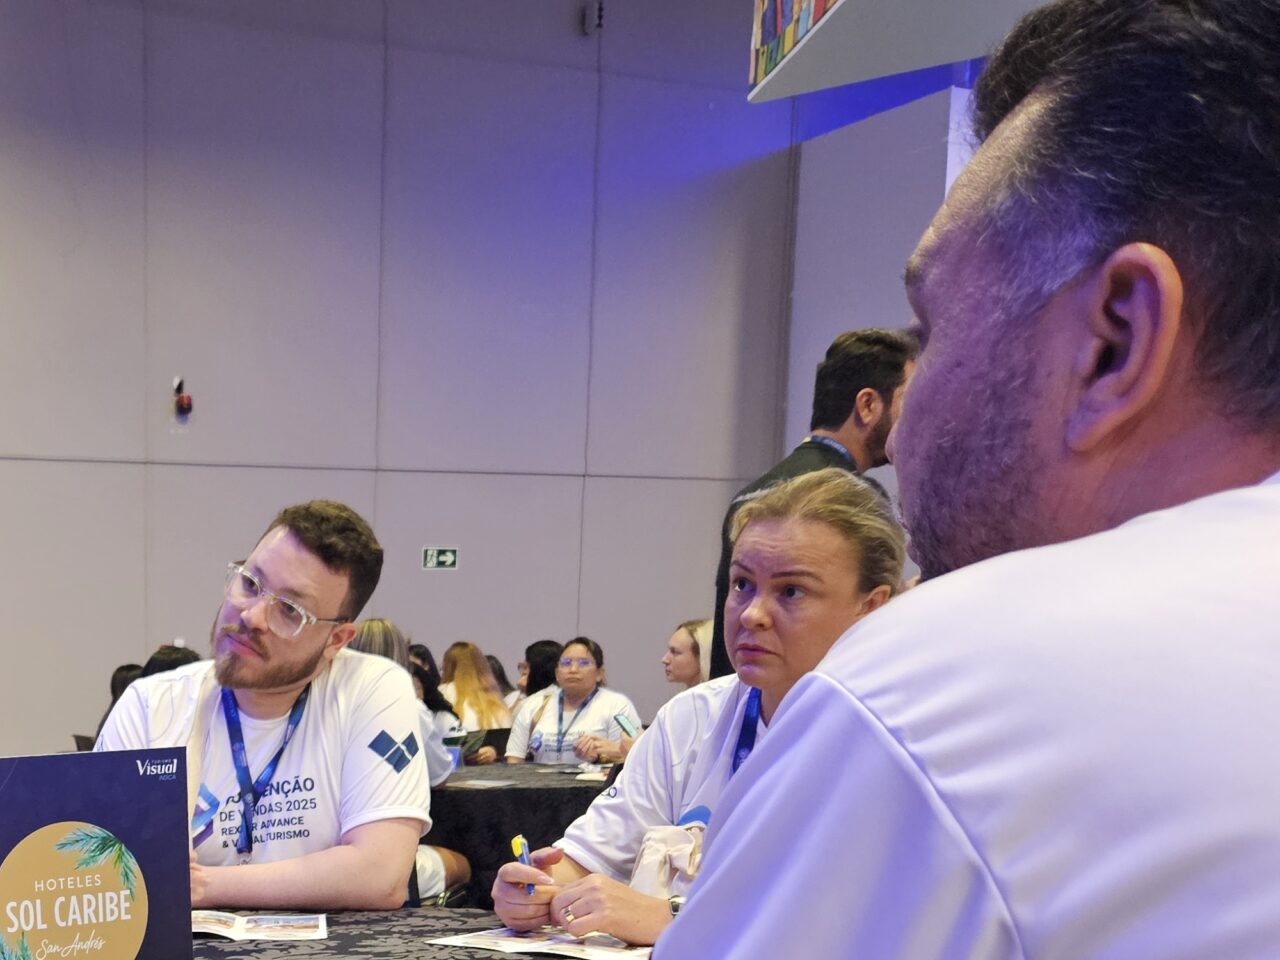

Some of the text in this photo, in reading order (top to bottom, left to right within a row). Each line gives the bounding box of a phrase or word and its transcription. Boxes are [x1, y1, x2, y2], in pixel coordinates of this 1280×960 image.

[136, 758, 178, 776] Visual
[220, 810, 236, 822] DE
[285, 798, 317, 812] 2025
[221, 822, 258, 836] REXR
[34, 874, 102, 892] HOTELES
[6, 889, 132, 933] SOL CARIBE
[35, 939, 62, 960] San
